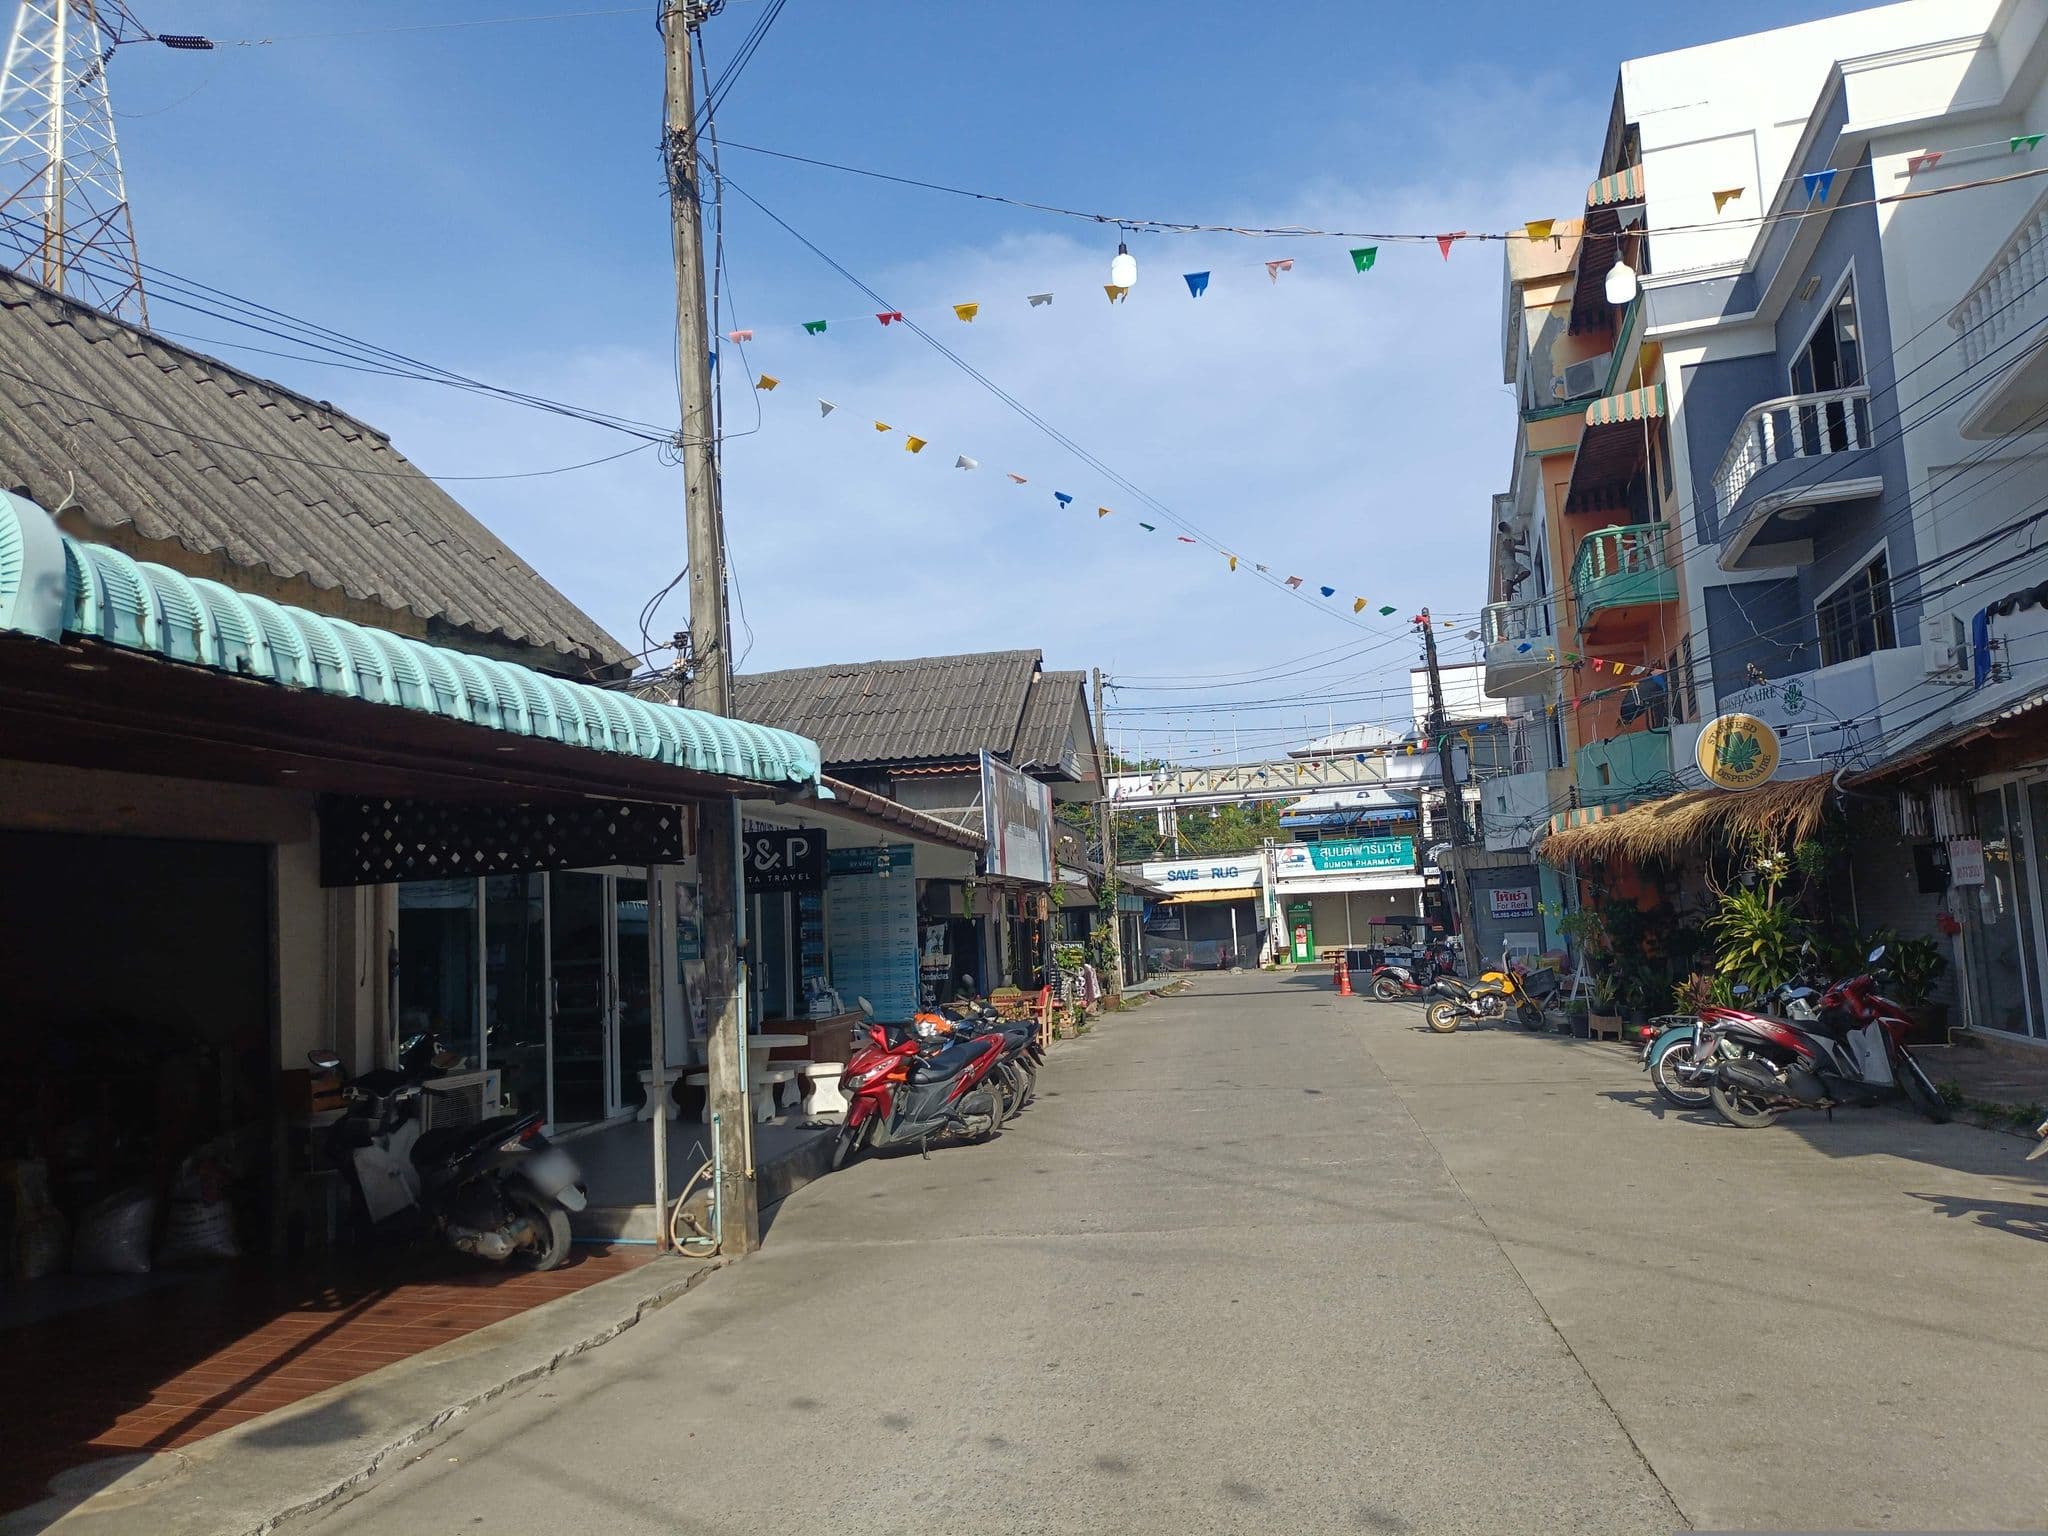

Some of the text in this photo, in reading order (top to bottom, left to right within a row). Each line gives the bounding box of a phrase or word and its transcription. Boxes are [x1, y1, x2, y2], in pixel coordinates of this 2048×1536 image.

[1717, 754, 1772, 783] DISPENSAIRE
[1324, 857, 1401, 869] SUMON PHARMACY
[768, 873, 811, 882] TRAVEL
[1167, 867, 1239, 881] SAVE RUG
[1496, 901, 1529, 910] For Rent
